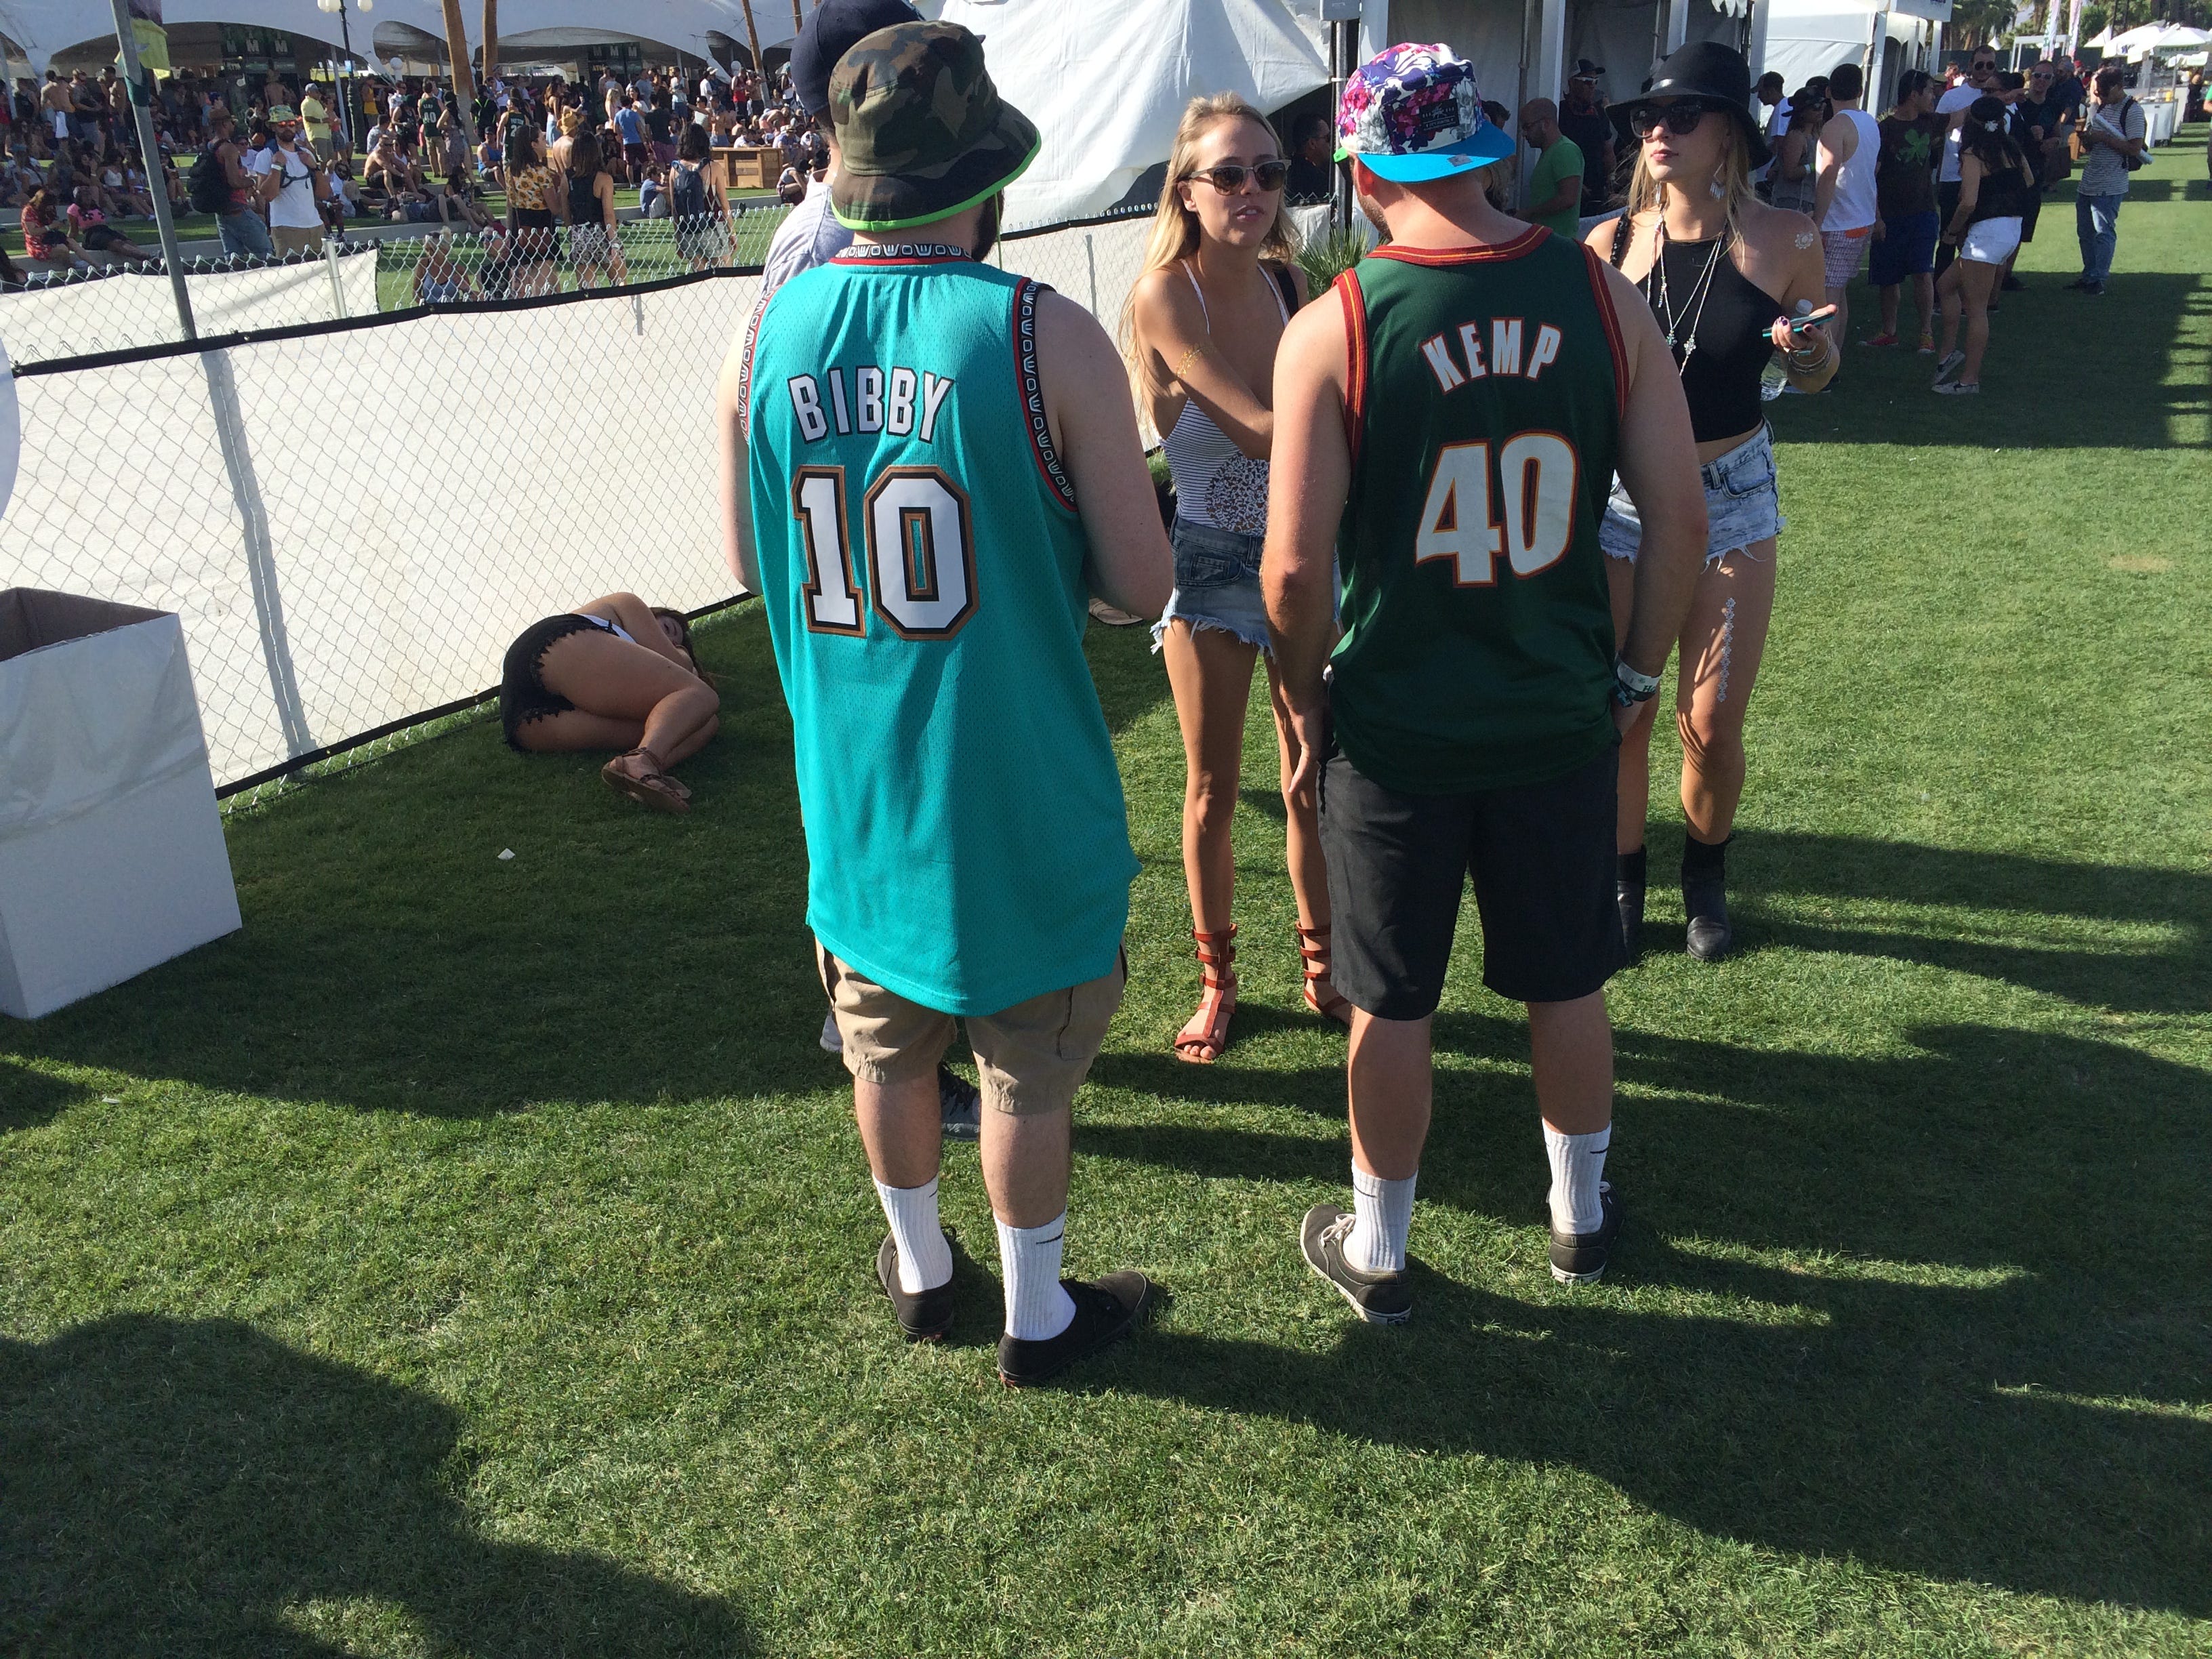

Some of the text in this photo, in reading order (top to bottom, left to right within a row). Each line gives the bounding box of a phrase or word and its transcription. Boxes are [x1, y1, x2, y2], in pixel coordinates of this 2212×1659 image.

[423, 112, 437, 123] 40
[1420, 316, 1563, 394] KEMP
[787, 365, 956, 444] BIBBY
[1414, 428, 1581, 588] 40
[790, 464, 980, 640] 10
